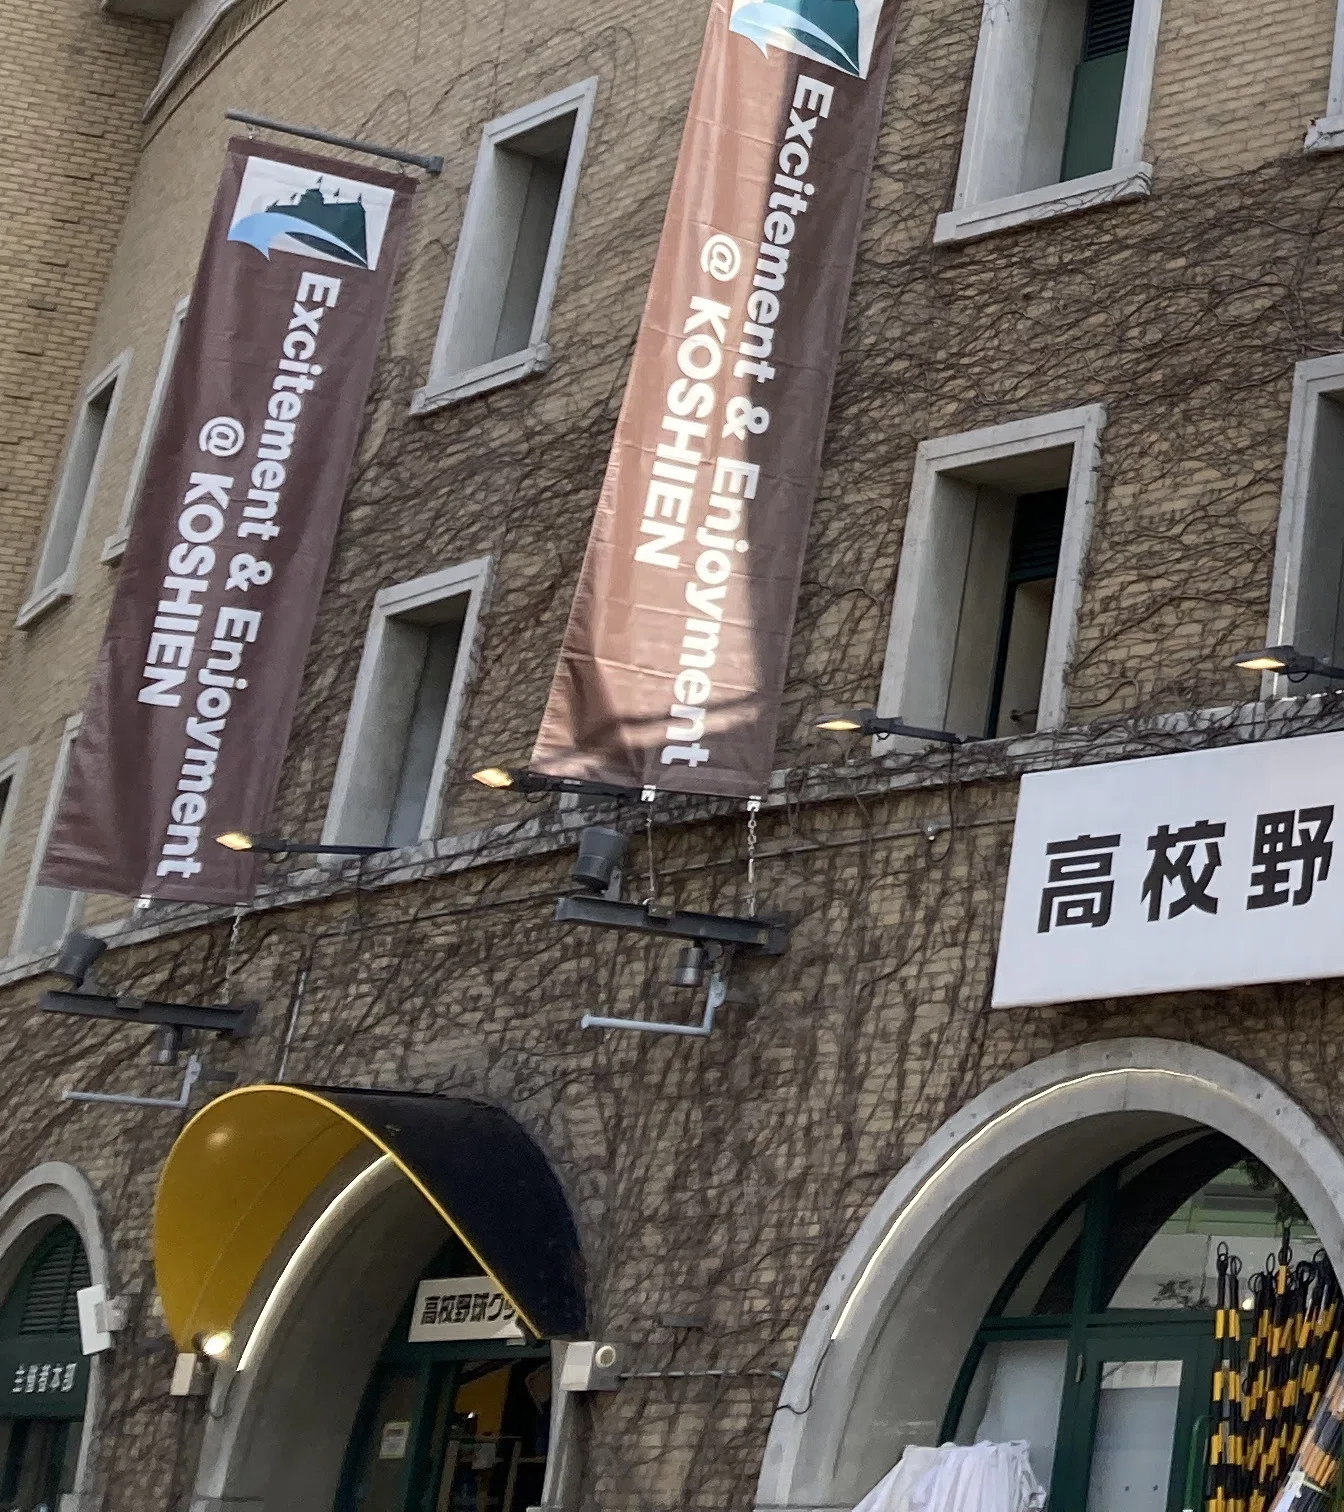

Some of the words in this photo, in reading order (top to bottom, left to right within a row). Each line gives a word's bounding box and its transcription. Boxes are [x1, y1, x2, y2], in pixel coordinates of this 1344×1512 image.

[700, 233, 741, 281] @
[733, 75, 834, 384] Excitement
[199, 416, 245, 457] @
[238, 272, 342, 544] Excitement
[634, 296, 732, 570] KOSHIEN
[725, 396, 769, 441] &
[138, 471, 225, 707] KOSHIEN
[228, 559, 272, 591] &
[659, 457, 760, 767] Enjoyment
[156, 608, 262, 878] Enjoyment
